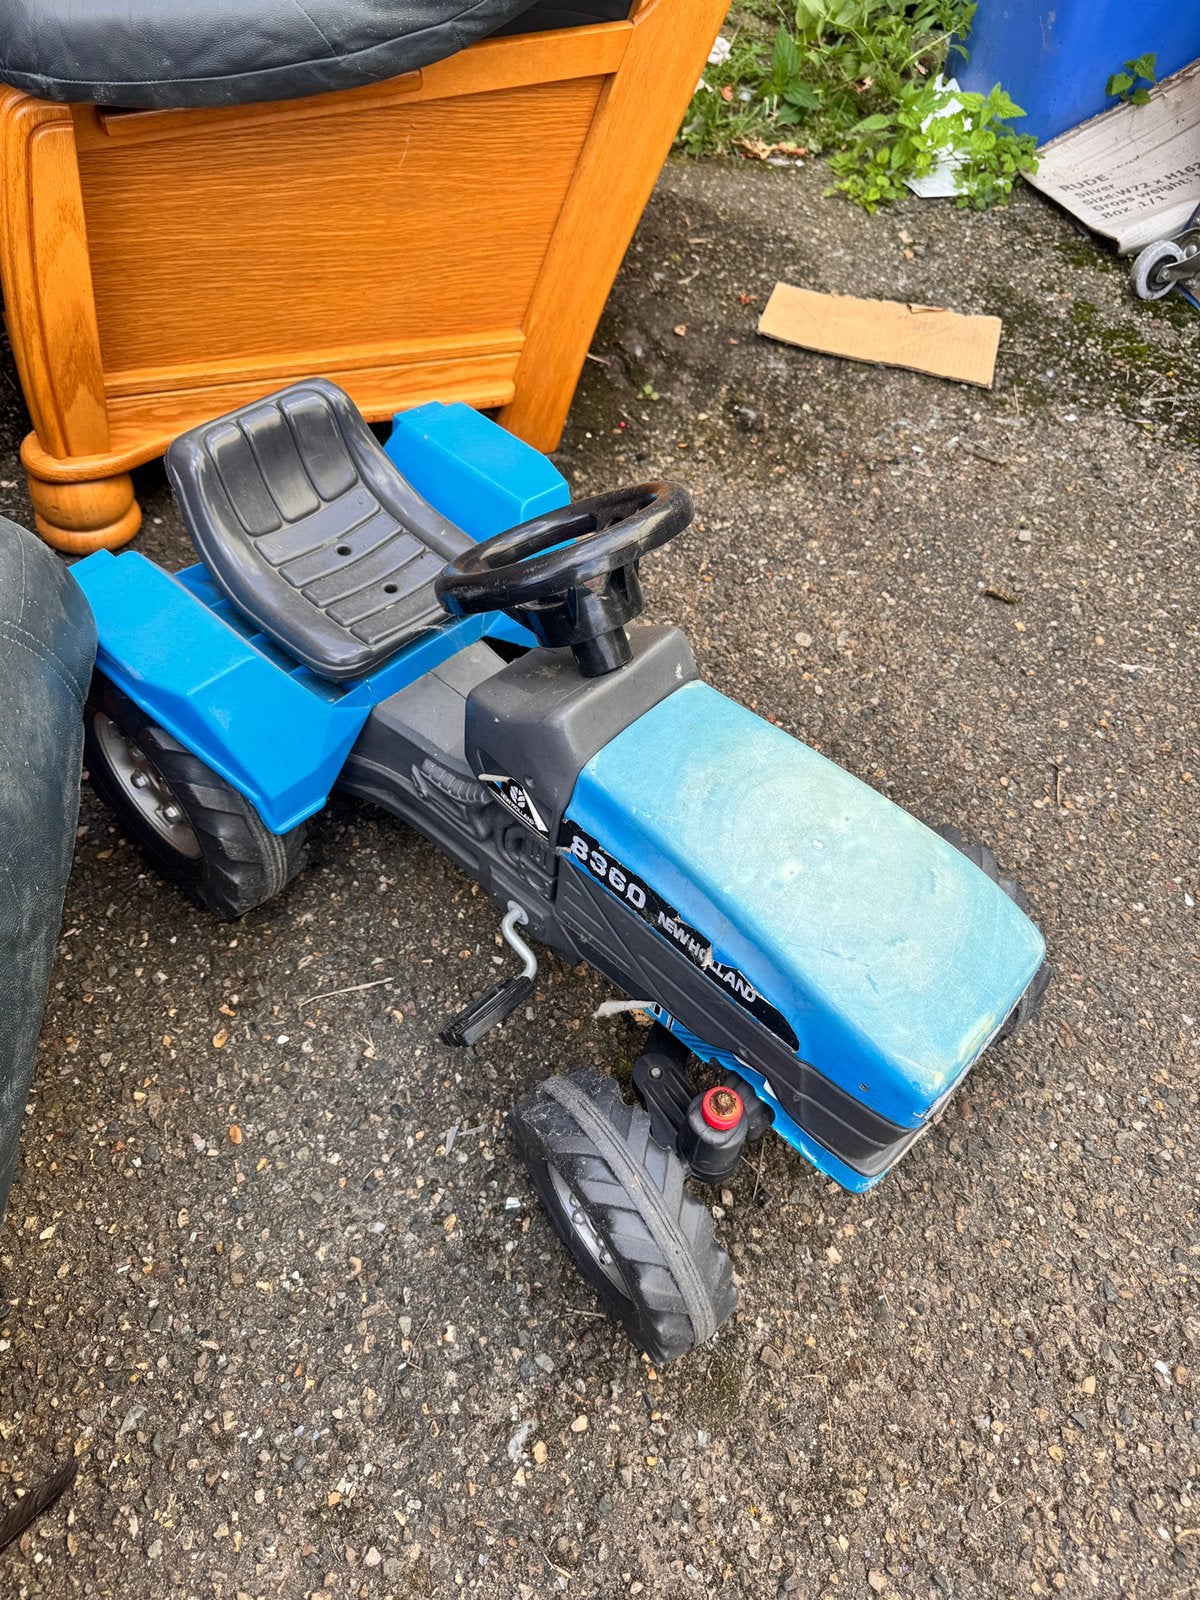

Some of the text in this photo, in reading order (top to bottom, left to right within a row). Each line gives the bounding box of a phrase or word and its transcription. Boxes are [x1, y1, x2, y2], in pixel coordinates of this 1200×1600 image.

[1058, 174, 1110, 191] RUDE
[1075, 184, 1115, 199] Silver
[1101, 207, 1132, 219] Box
[571, 835, 647, 909] 8360
[658, 911, 690, 945] NEW
